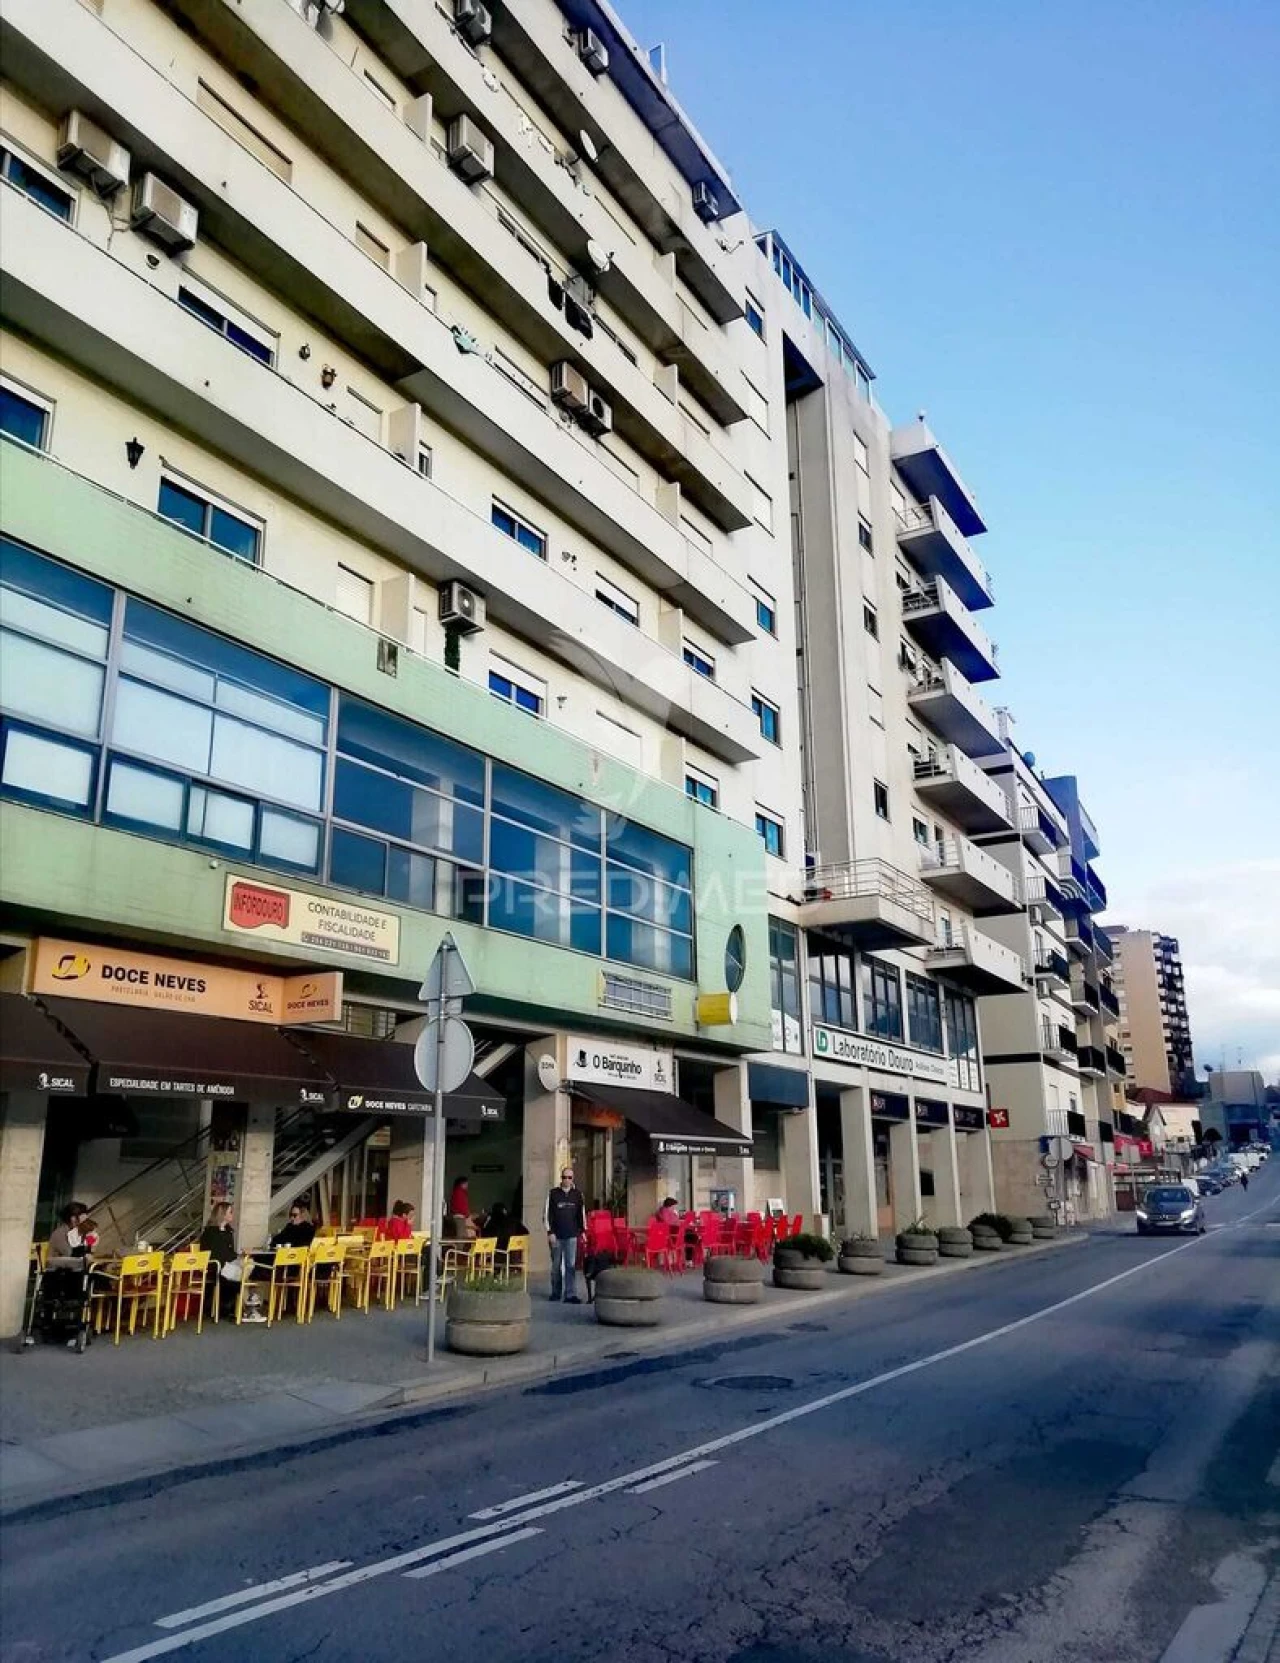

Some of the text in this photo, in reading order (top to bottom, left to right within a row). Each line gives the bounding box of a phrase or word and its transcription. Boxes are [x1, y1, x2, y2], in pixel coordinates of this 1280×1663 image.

[308, 902, 380, 928] CONTABILIDADE
[318, 919, 377, 941] FISCALIDADE
[101, 965, 206, 993] DOCE NEVES
[249, 1000, 274, 1013] SICAL
[286, 999, 329, 1010] DOCE NEVES
[832, 1035, 886, 1066] Laboratório
[888, 1050, 914, 1073] Douro
[592, 1055, 600, 1069] O
[603, 1057, 642, 1079] Barquinho
[51, 1078, 75, 1087] SICAL
[109, 1077, 158, 1090] ESPECIALIDADE
